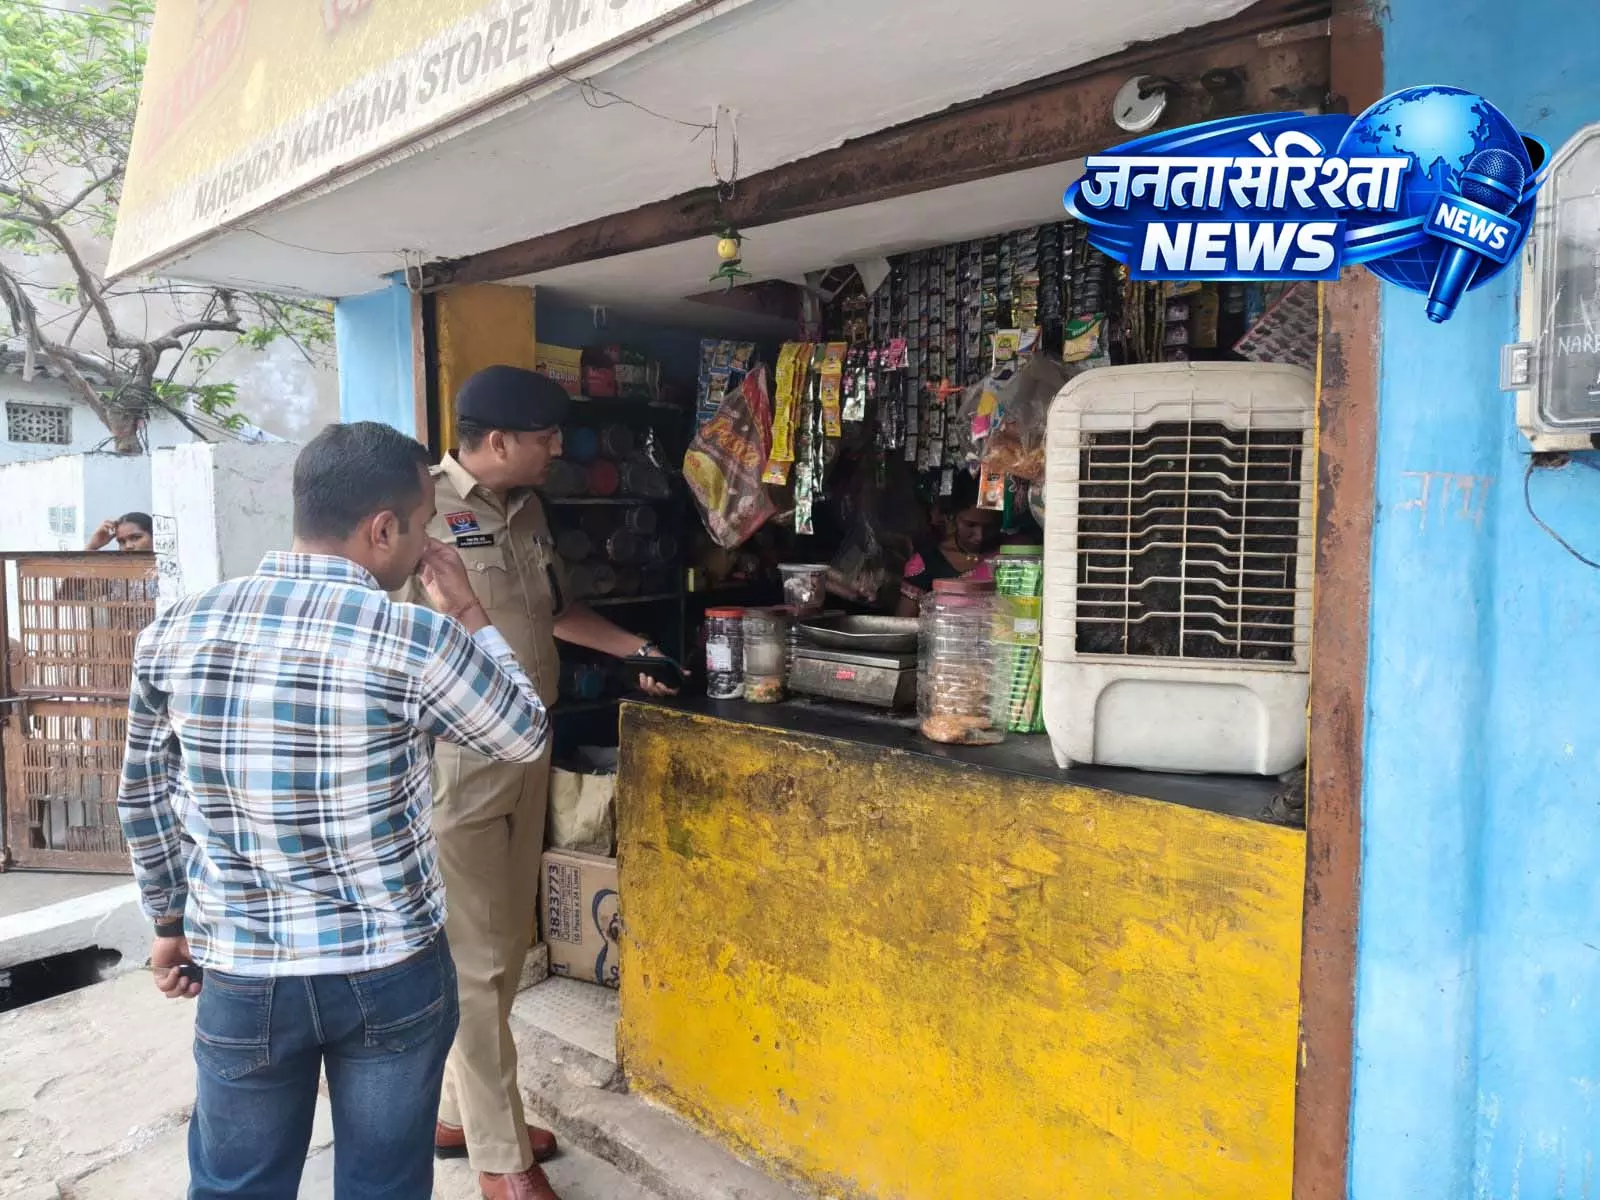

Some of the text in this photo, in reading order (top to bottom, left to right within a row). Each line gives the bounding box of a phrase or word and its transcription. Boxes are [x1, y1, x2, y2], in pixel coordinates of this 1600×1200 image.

[192, 140, 285, 220] NARENDR
[290, 72, 408, 171] KARYANA
[415, 4, 533, 104] STORE
[548, 864, 561, 938] 3823773
